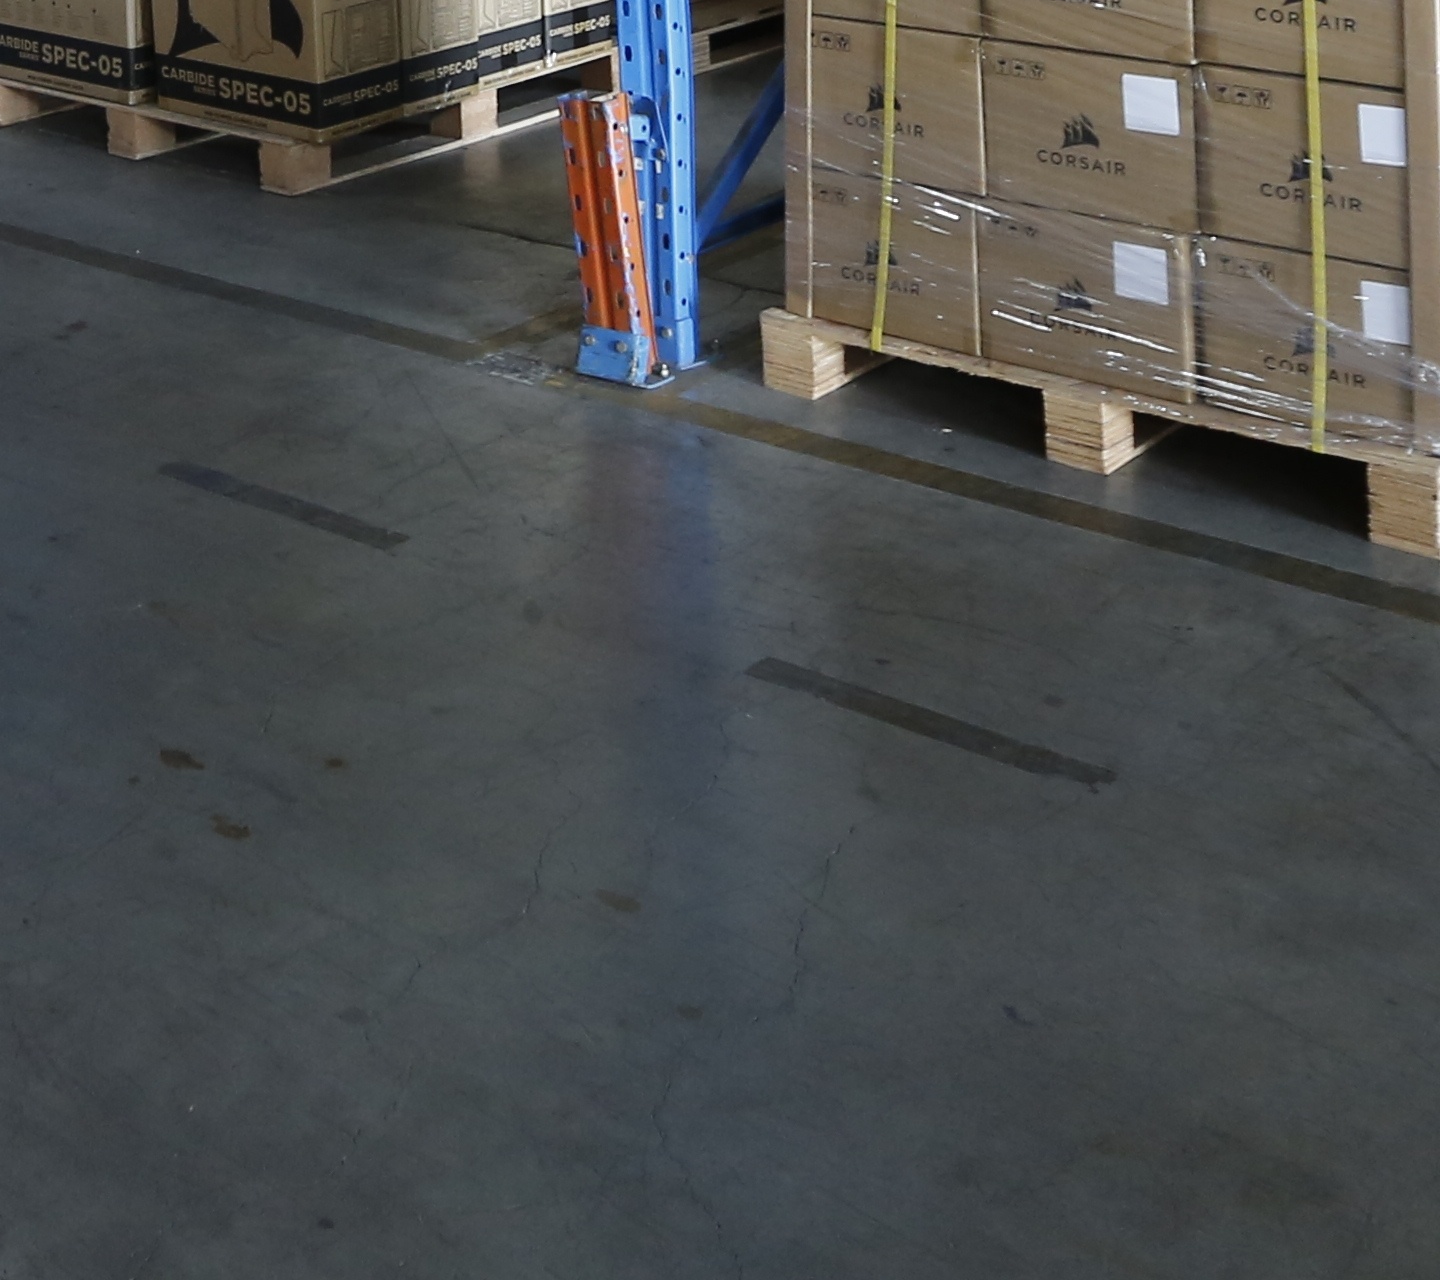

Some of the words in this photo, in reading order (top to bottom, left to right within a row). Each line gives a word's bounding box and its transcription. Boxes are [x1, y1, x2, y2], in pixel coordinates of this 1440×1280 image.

[574, 14, 610, 34] SPEC-05
[1255, 7, 1356, 32] CORAIR
[502, 34, 541, 55] SPEC-05
[42, 43, 123, 78] SPEC-05
[437, 56, 478, 78] SPEC-05
[161, 66, 215, 88] CARBIDE
[219, 78, 311, 115] SPEC-05
[354, 79, 399, 102] SPEC-05
[1037, 150, 1125, 175] CORSAIR
[1260, 182, 1362, 211] CORAIR
[841, 266, 921, 296] CORAIR
[1263, 355, 1367, 388] CORAIR
